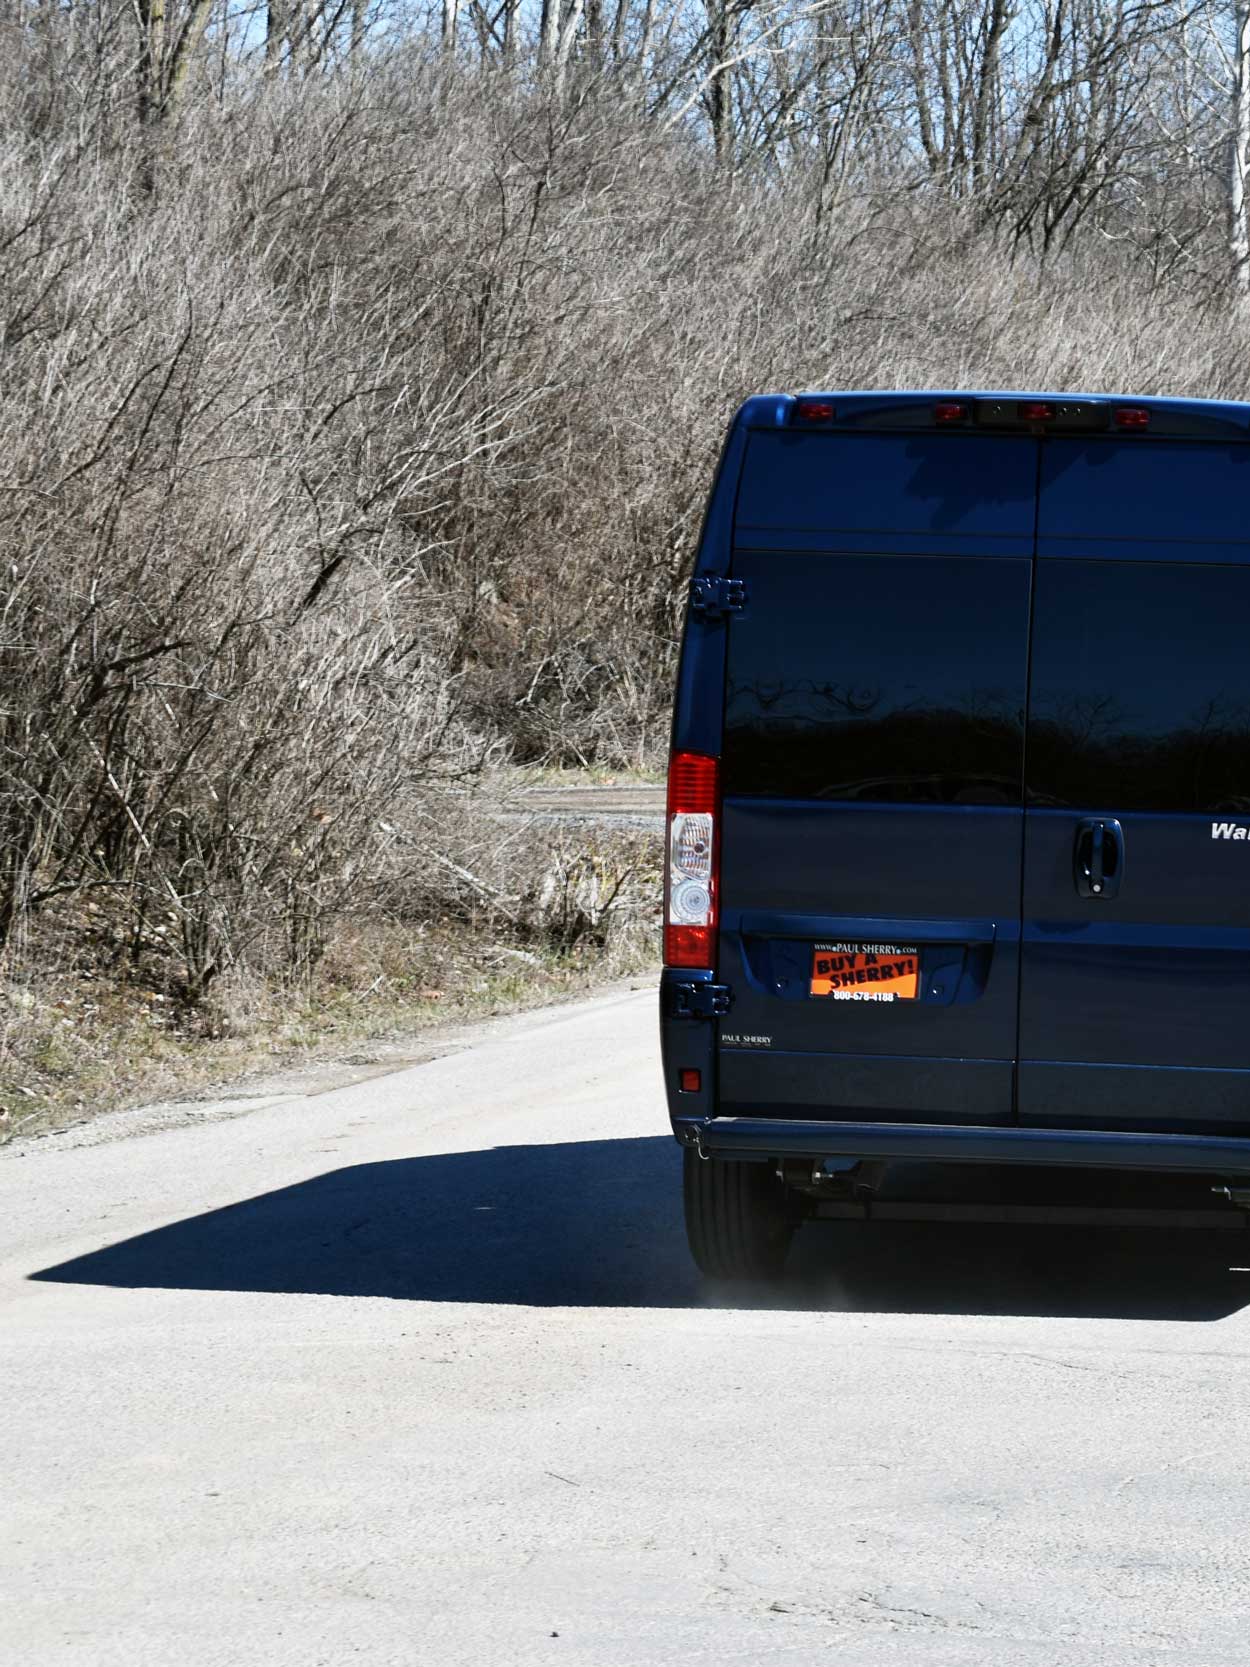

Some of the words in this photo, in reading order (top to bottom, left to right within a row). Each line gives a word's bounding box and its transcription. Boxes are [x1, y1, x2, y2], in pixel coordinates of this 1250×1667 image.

[816, 955, 858, 975] BUY
[864, 954, 878, 966] A
[829, 959, 914, 989] SHERRY!
[721, 1034, 741, 1042] PAUL
[743, 1035, 771, 1043] SHERRY
